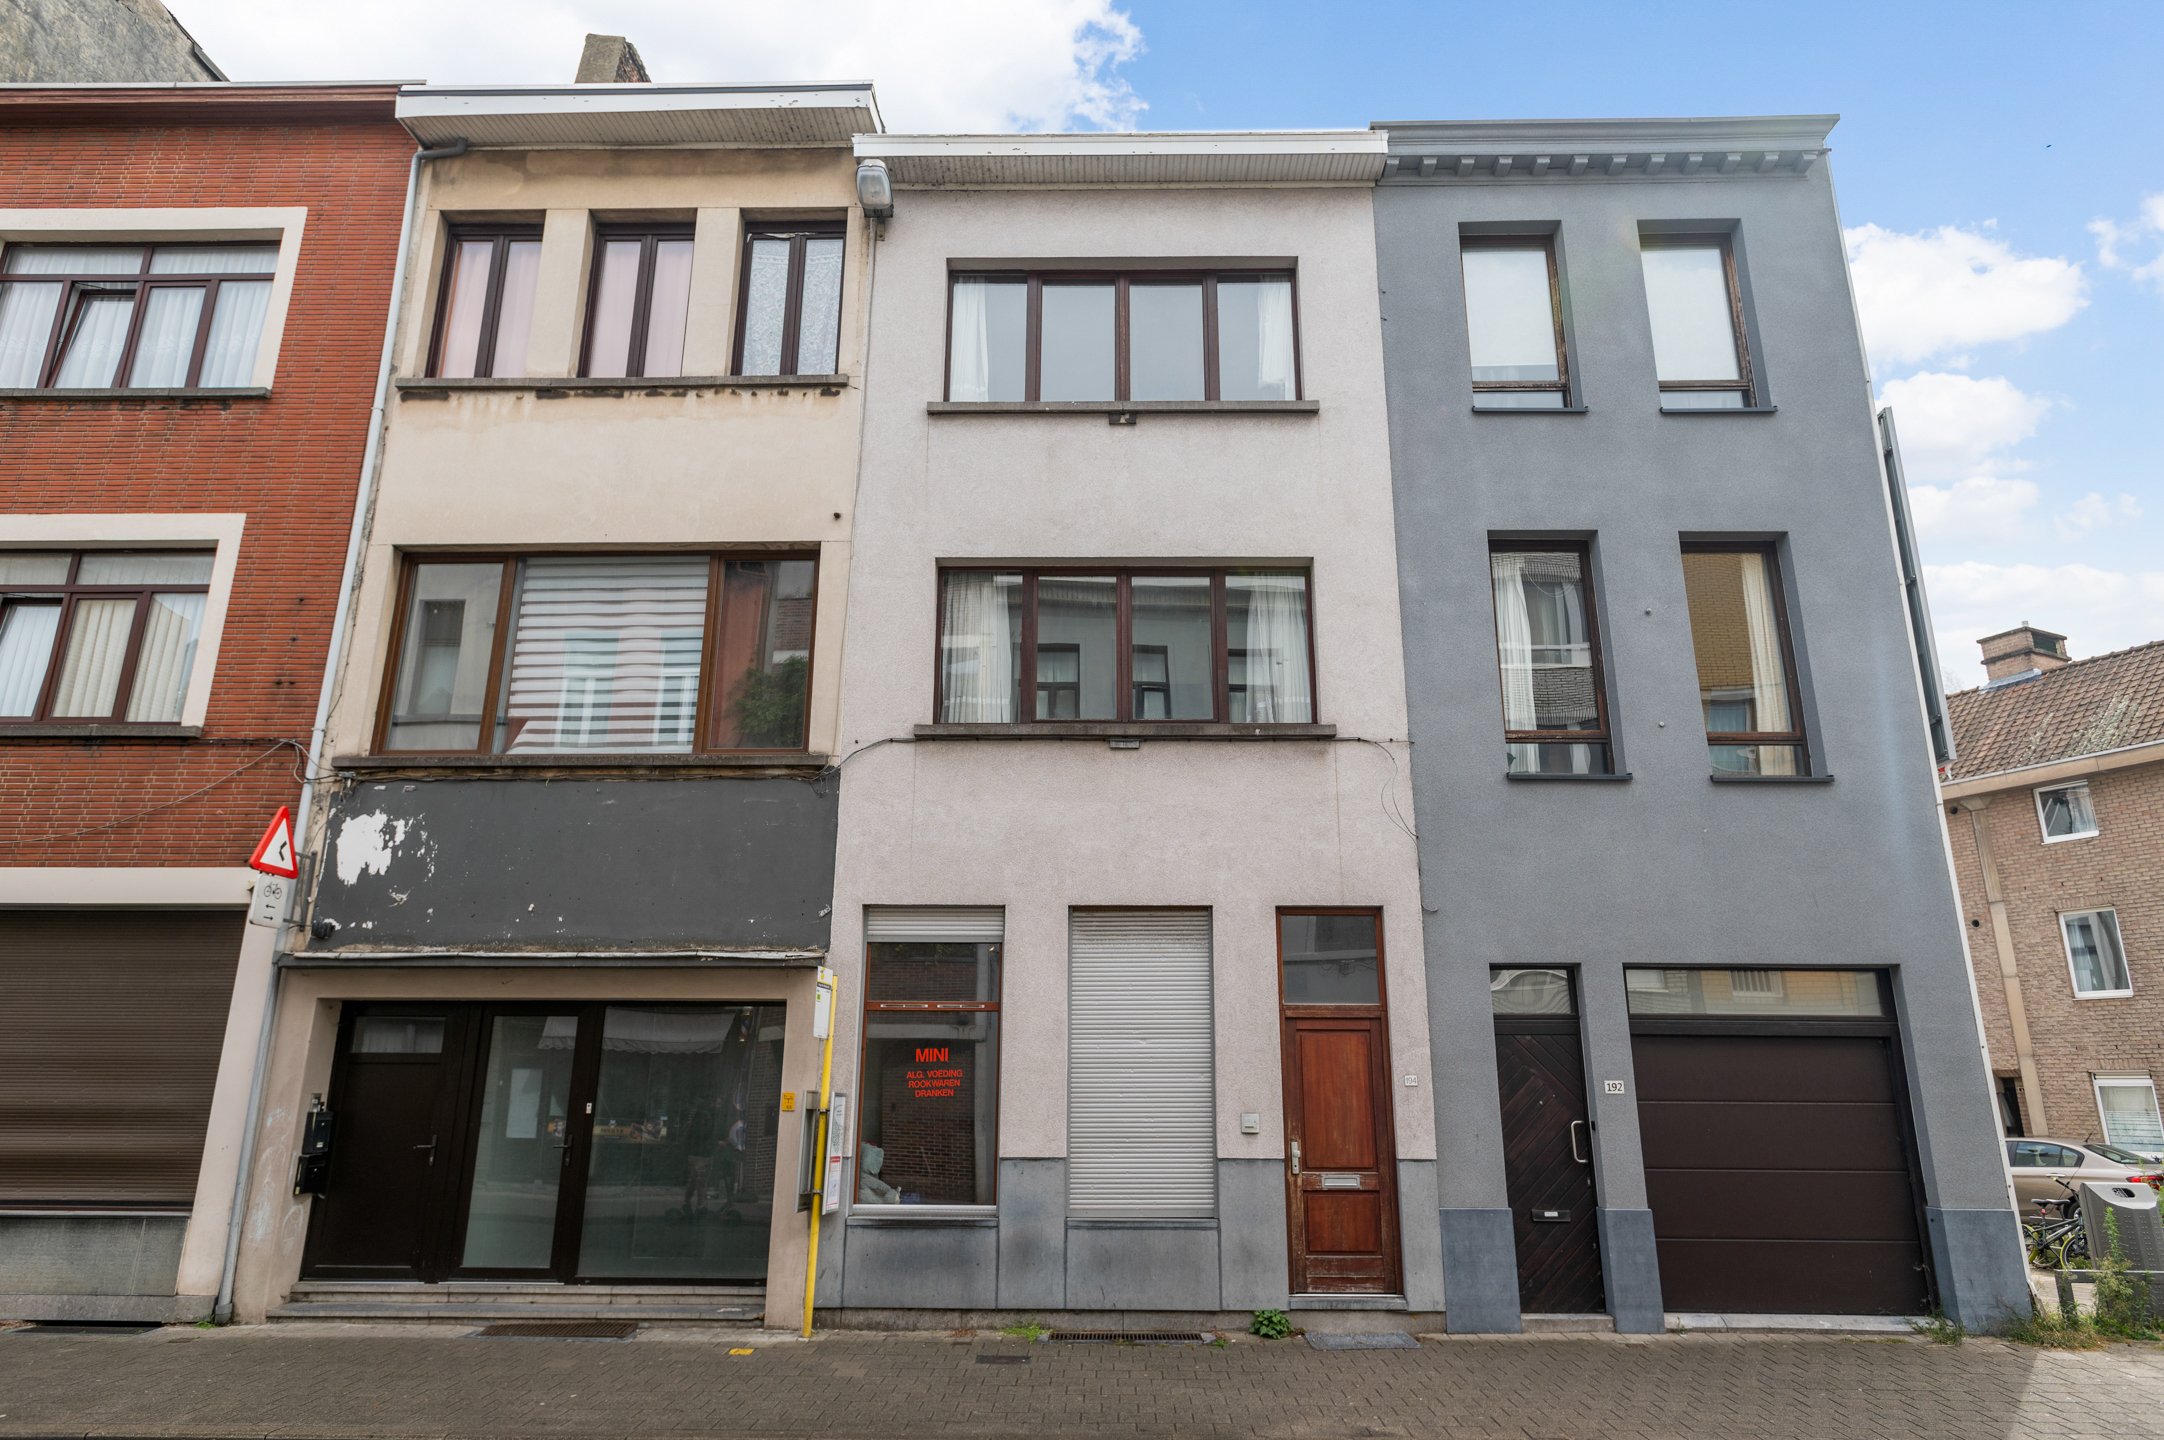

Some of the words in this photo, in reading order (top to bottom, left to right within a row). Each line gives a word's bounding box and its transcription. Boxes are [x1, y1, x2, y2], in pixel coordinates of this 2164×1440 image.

[916, 1048, 949, 1062] MINI
[927, 1070, 963, 1078] VOEDING
[908, 1080, 961, 1088] ROOKWAREN
[1607, 1082, 1623, 1092] 192
[915, 1089, 954, 1097] DRANKEN
